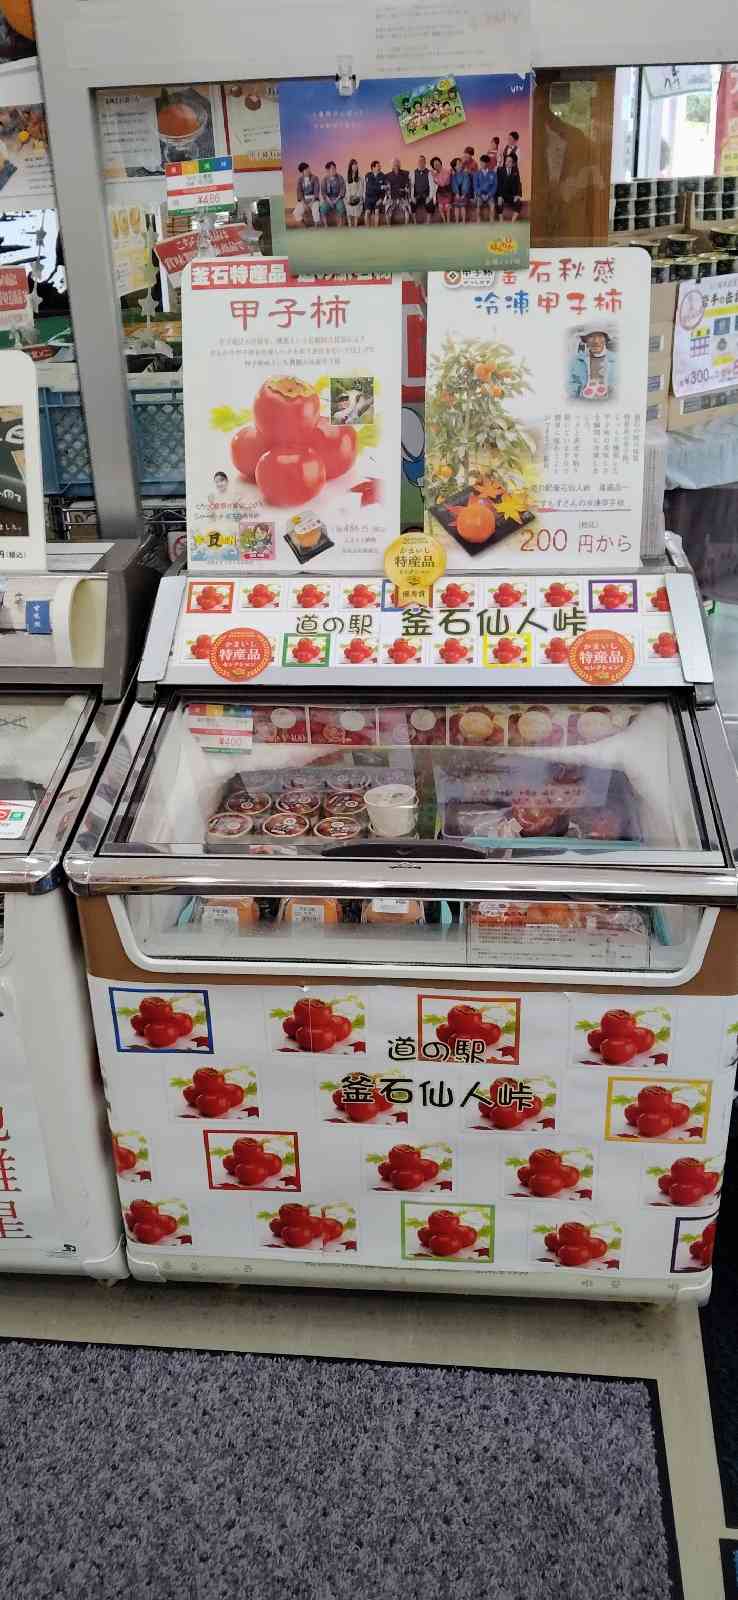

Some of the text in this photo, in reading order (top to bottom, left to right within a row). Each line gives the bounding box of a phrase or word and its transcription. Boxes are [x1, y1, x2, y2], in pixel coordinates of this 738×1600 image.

[229, 295, 351, 331] 甲子柿
[473, 288, 624, 316] 冷凍甲子柿
[519, 528, 632, 553] 200 円から
[394, 555, 435, 568] 特産品
[295, 606, 587, 637] 道の駅 釜石仙人峠
[219, 648, 261, 660] 特産品
[580, 651, 624, 664] 特産品
[387, 1036, 486, 1064] 道の駅
[340, 1071, 535, 1112] 釜石仙人峠
